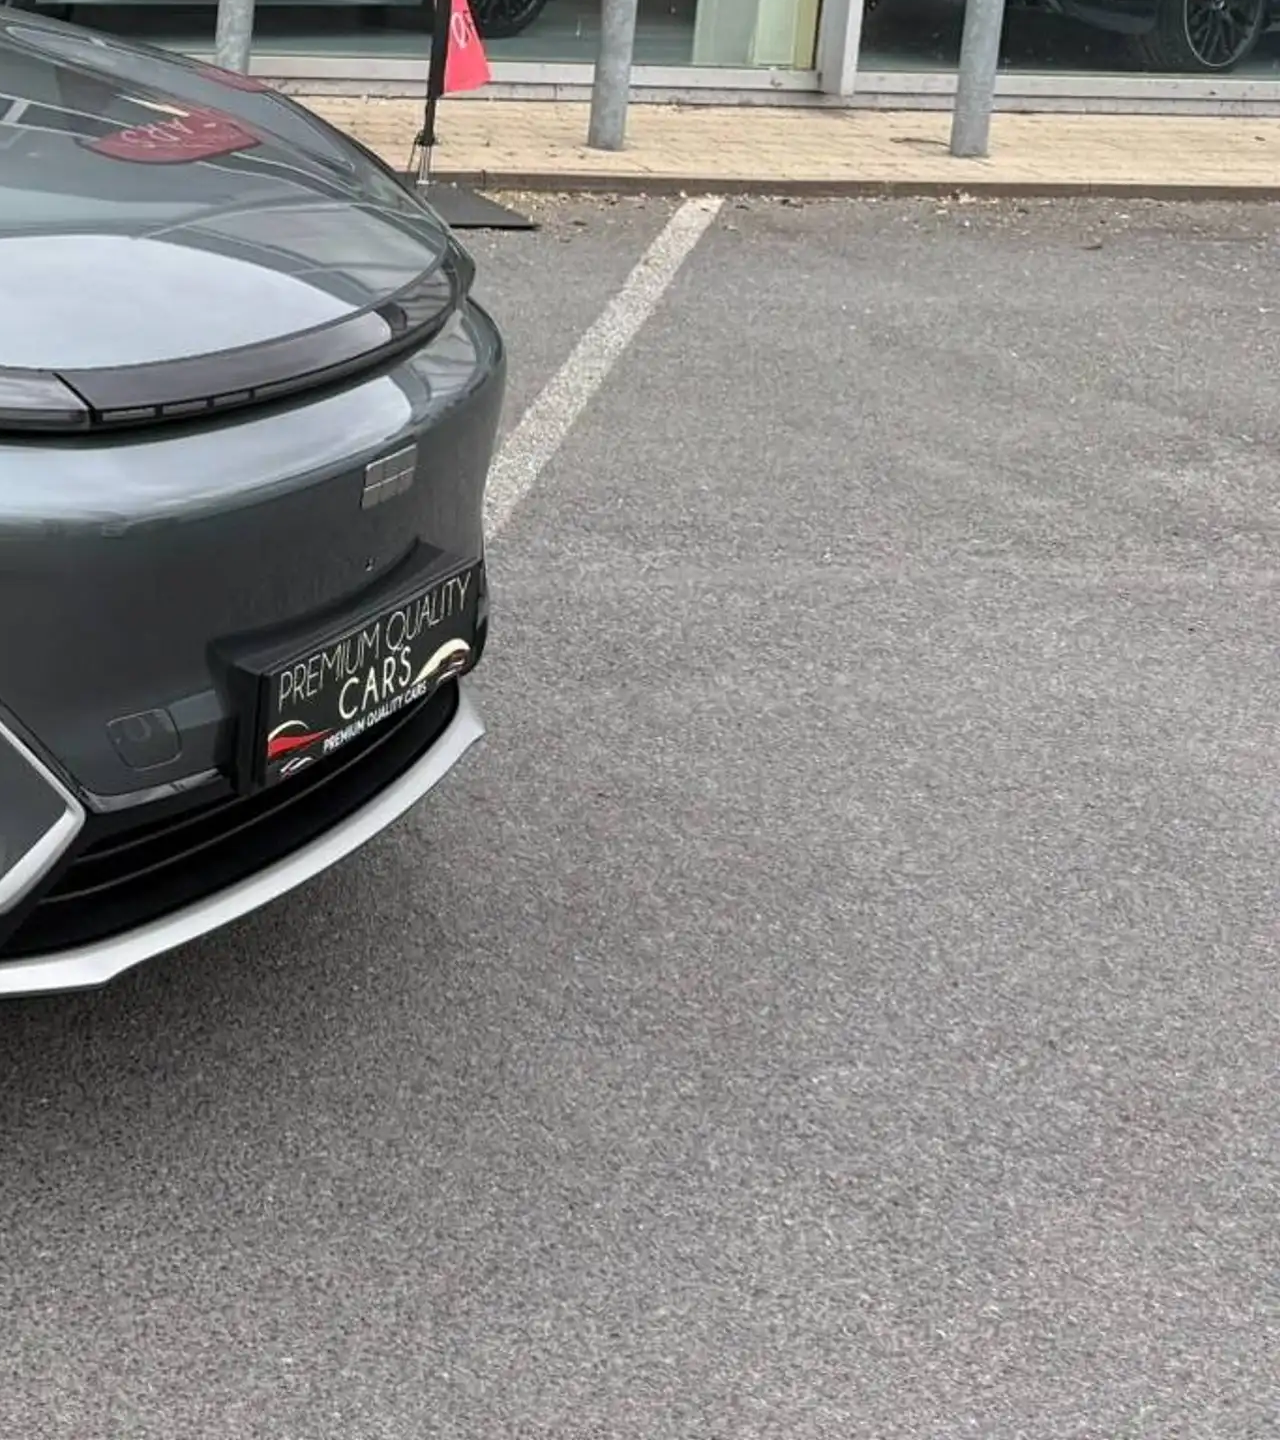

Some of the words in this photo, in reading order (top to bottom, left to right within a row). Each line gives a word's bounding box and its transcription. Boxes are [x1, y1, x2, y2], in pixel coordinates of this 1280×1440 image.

[278, 622, 381, 713] PREMIUM
[385, 570, 472, 653] QUALITY
[323, 716, 366, 755] PREMIUM
[366, 693, 403, 728] QUALITY
[404, 680, 427, 704] CARS
[338, 646, 411, 719] CARS
